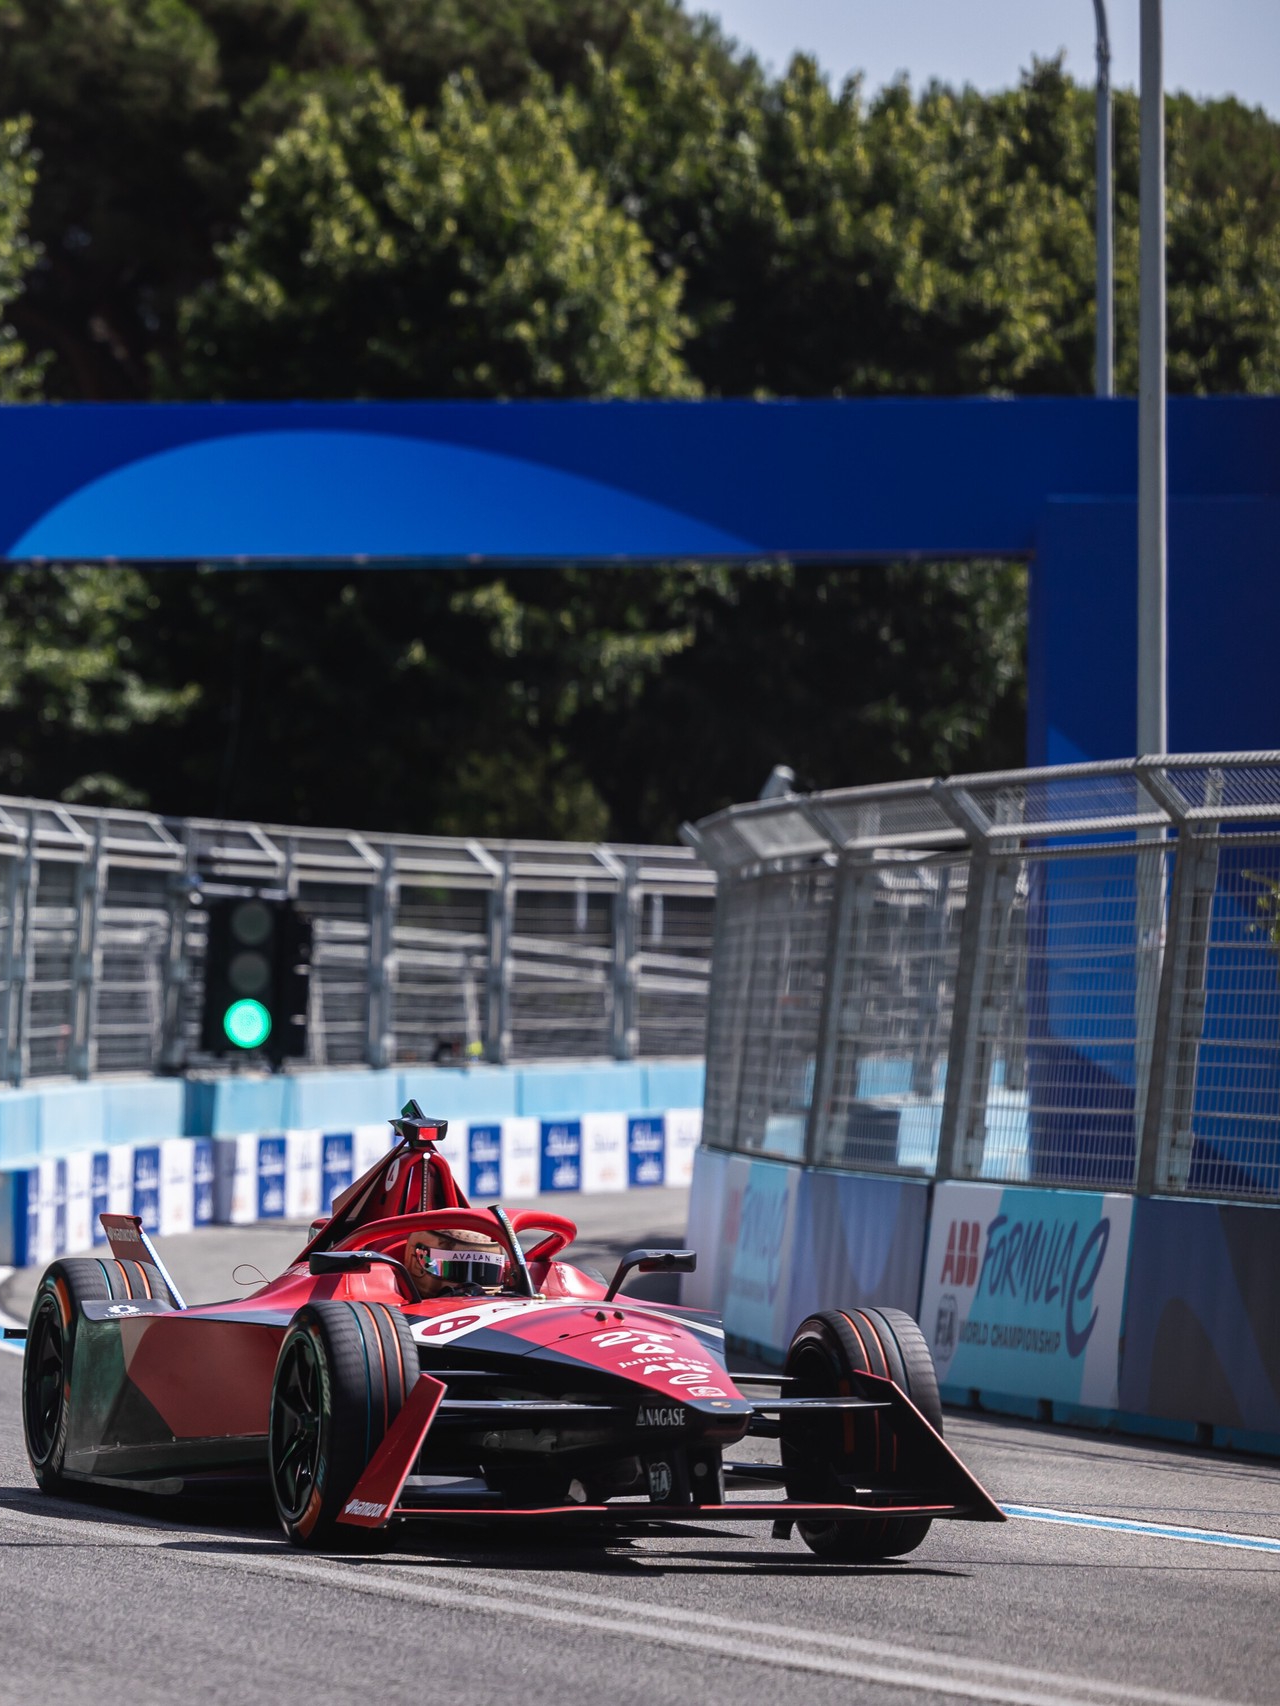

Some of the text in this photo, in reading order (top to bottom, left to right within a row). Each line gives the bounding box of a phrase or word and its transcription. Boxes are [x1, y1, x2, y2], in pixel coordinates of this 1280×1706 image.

[452, 1252, 491, 1262] AVALAN
[940, 1220, 981, 1287] ABB
[976, 1215, 1079, 1308] FORMULA
[591, 1328, 673, 1348] 27
[959, 1320, 1061, 1354] WORLD CHAMPIONSHIP
[646, 1408, 686, 1426] NAGASE
